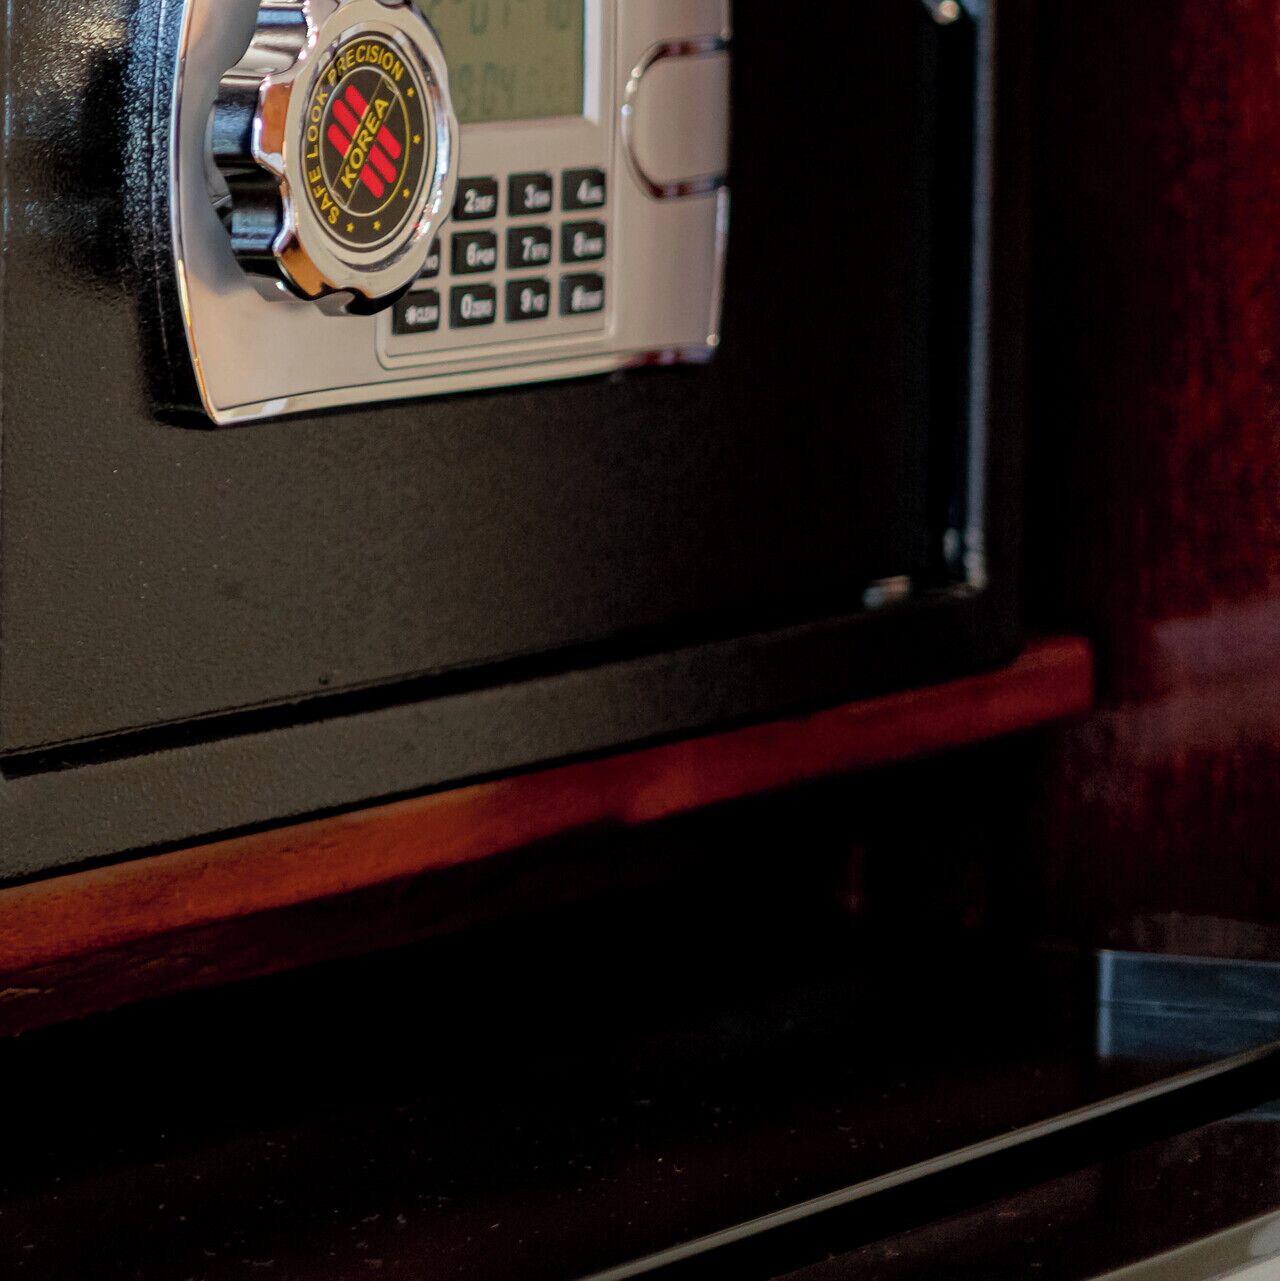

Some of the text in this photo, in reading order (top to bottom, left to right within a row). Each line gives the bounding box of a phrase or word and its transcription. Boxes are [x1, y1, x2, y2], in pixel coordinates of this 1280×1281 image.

[306, 44, 404, 225] SAFE LOOK PRECISION
[339, 97, 389, 190] KOREA
